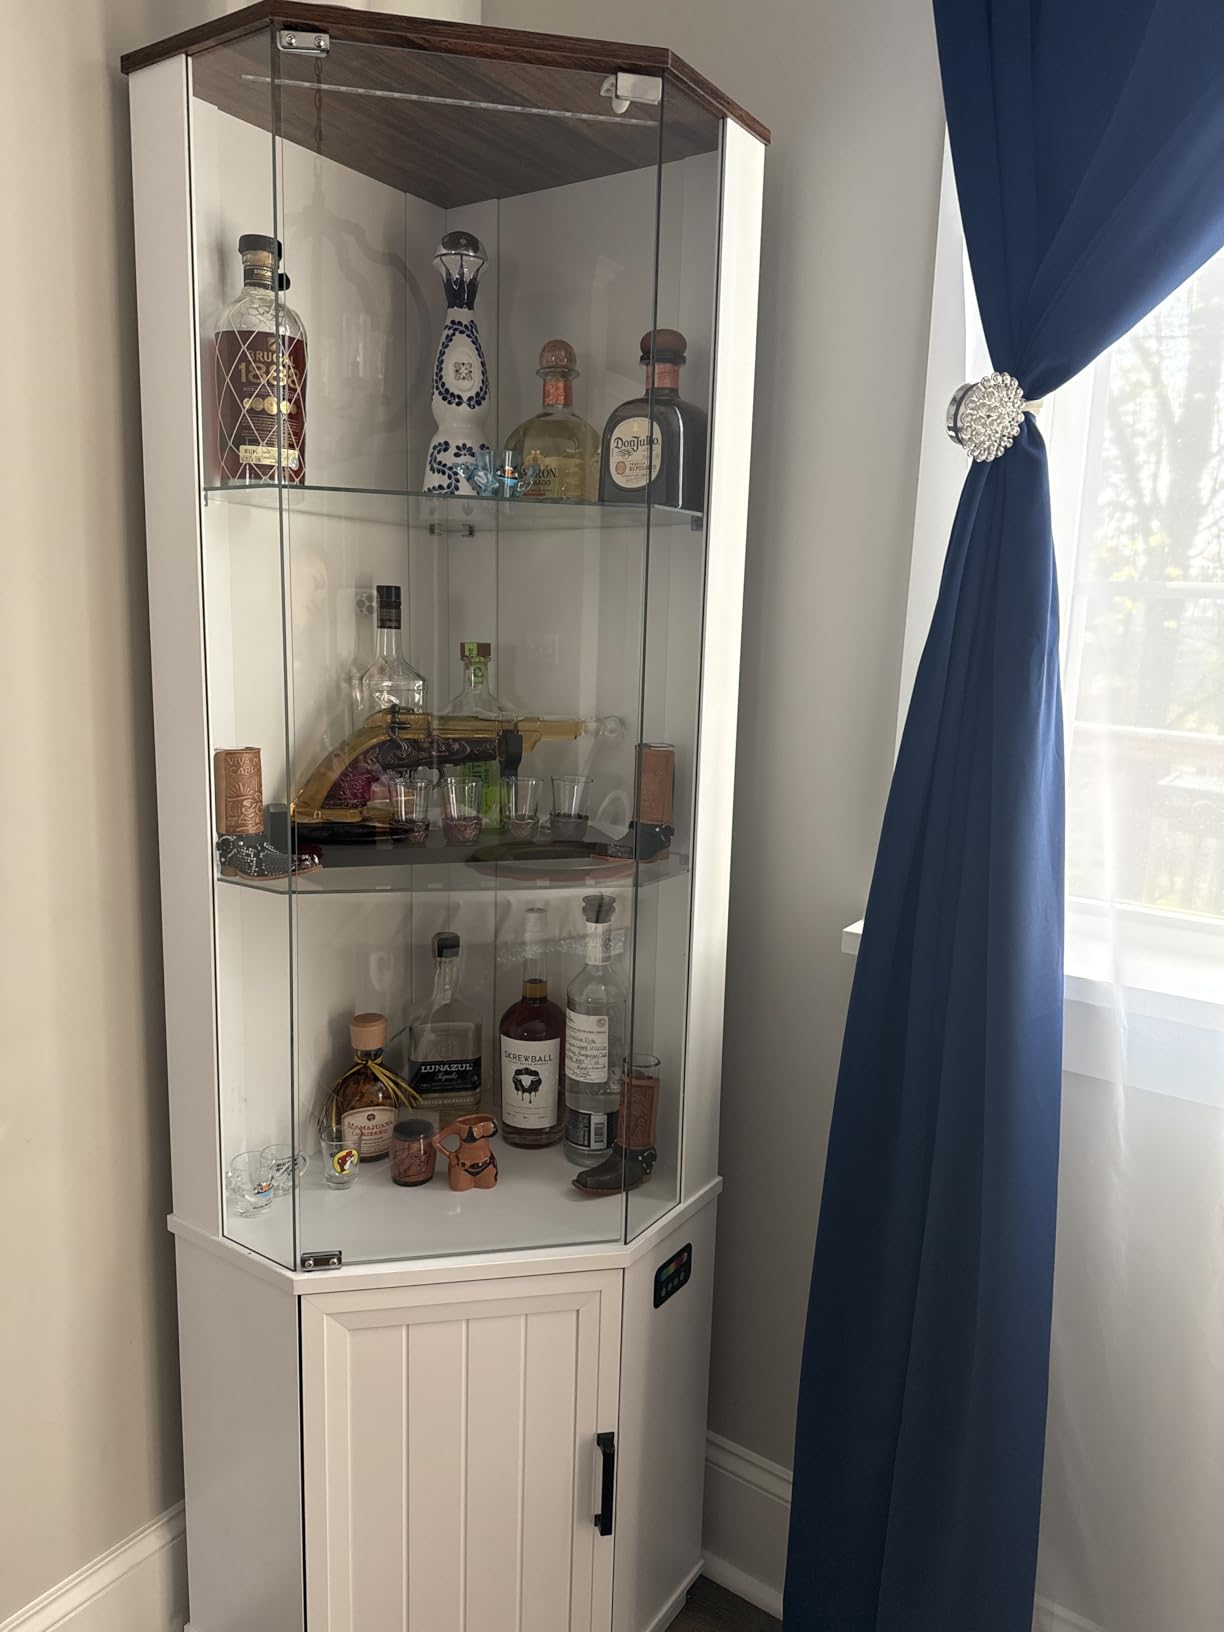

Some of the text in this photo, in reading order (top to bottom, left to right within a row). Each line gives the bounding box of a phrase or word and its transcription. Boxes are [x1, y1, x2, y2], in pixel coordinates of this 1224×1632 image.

[239, 362, 299, 389] 1888
[227, 757, 250, 766] VIVA
[504, 1050, 553, 1063] SKREWBALL
[421, 1064, 473, 1073] LUNAZUL
